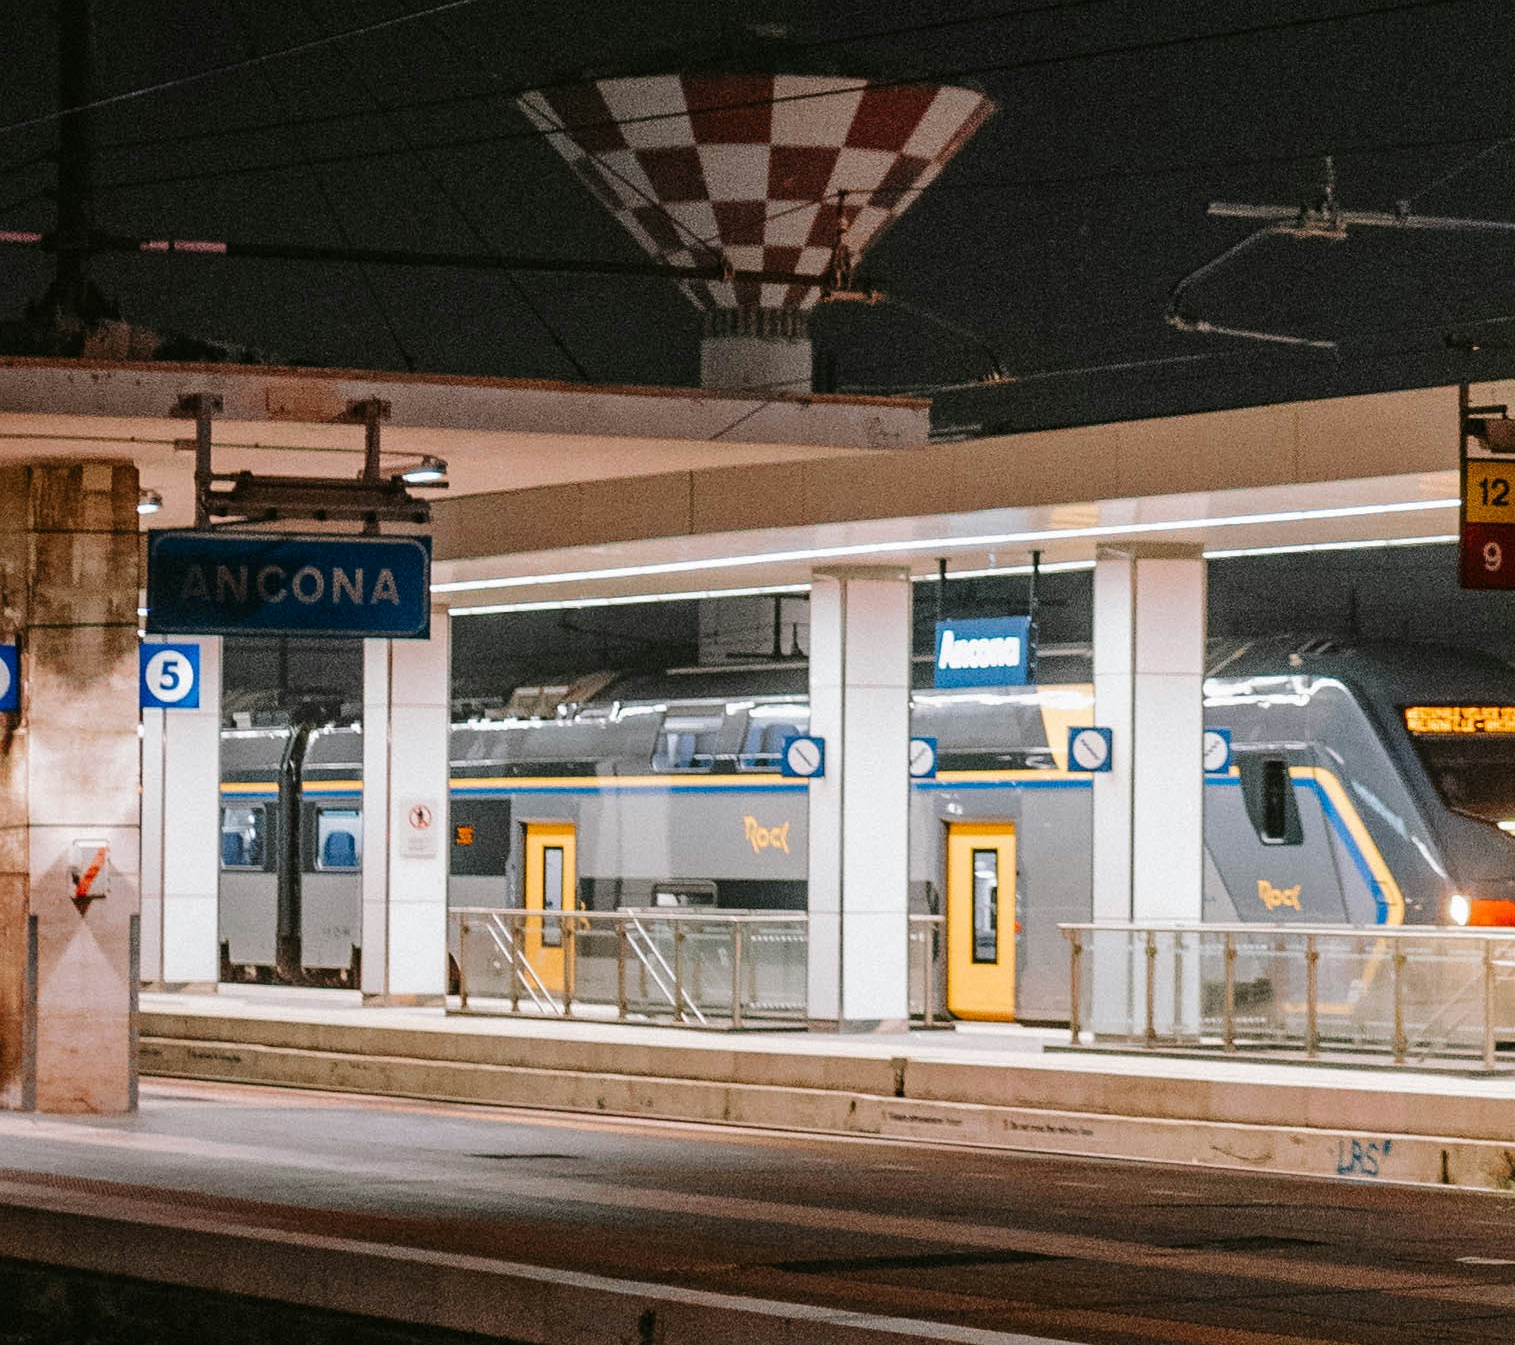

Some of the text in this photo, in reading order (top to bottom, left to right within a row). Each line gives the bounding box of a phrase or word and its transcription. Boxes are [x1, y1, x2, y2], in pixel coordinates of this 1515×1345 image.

[1479, 478, 1511, 507] 12
[1482, 540, 1503, 572] 9
[181, 564, 401, 606] ANCONA
[938, 629, 1021, 670] Ancona
[158, 659, 181, 691] 5
